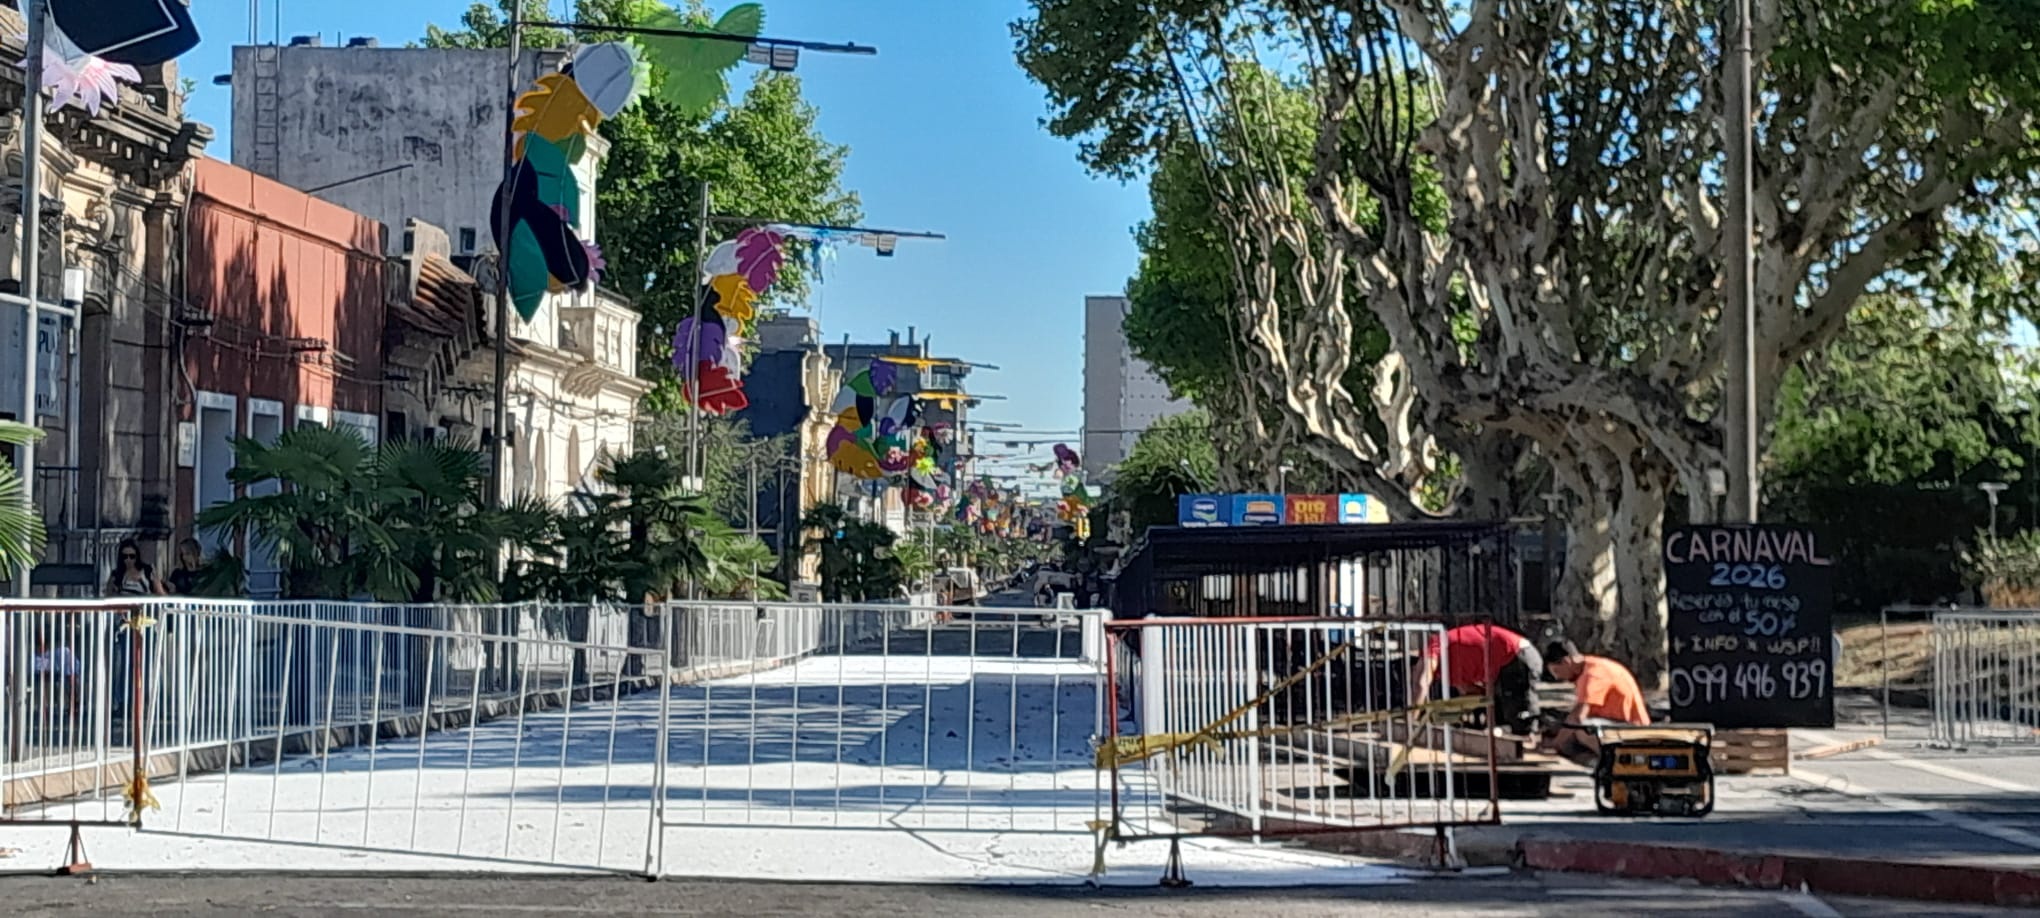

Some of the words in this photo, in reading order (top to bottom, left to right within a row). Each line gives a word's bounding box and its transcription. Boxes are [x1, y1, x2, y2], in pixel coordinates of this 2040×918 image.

[1665, 528, 1832, 565] CARNAVAL
[1709, 562, 1787, 590] 2026
[1741, 593, 1759, 610] tu
[1698, 609, 1725, 623] con
[1728, 607, 1741, 624] el
[1673, 636, 1685, 655] +
[1691, 636, 1739, 653] INFO
[1670, 662, 1729, 707] 099
[1734, 661, 1777, 699] 496
[1781, 658, 1827, 699] 939
